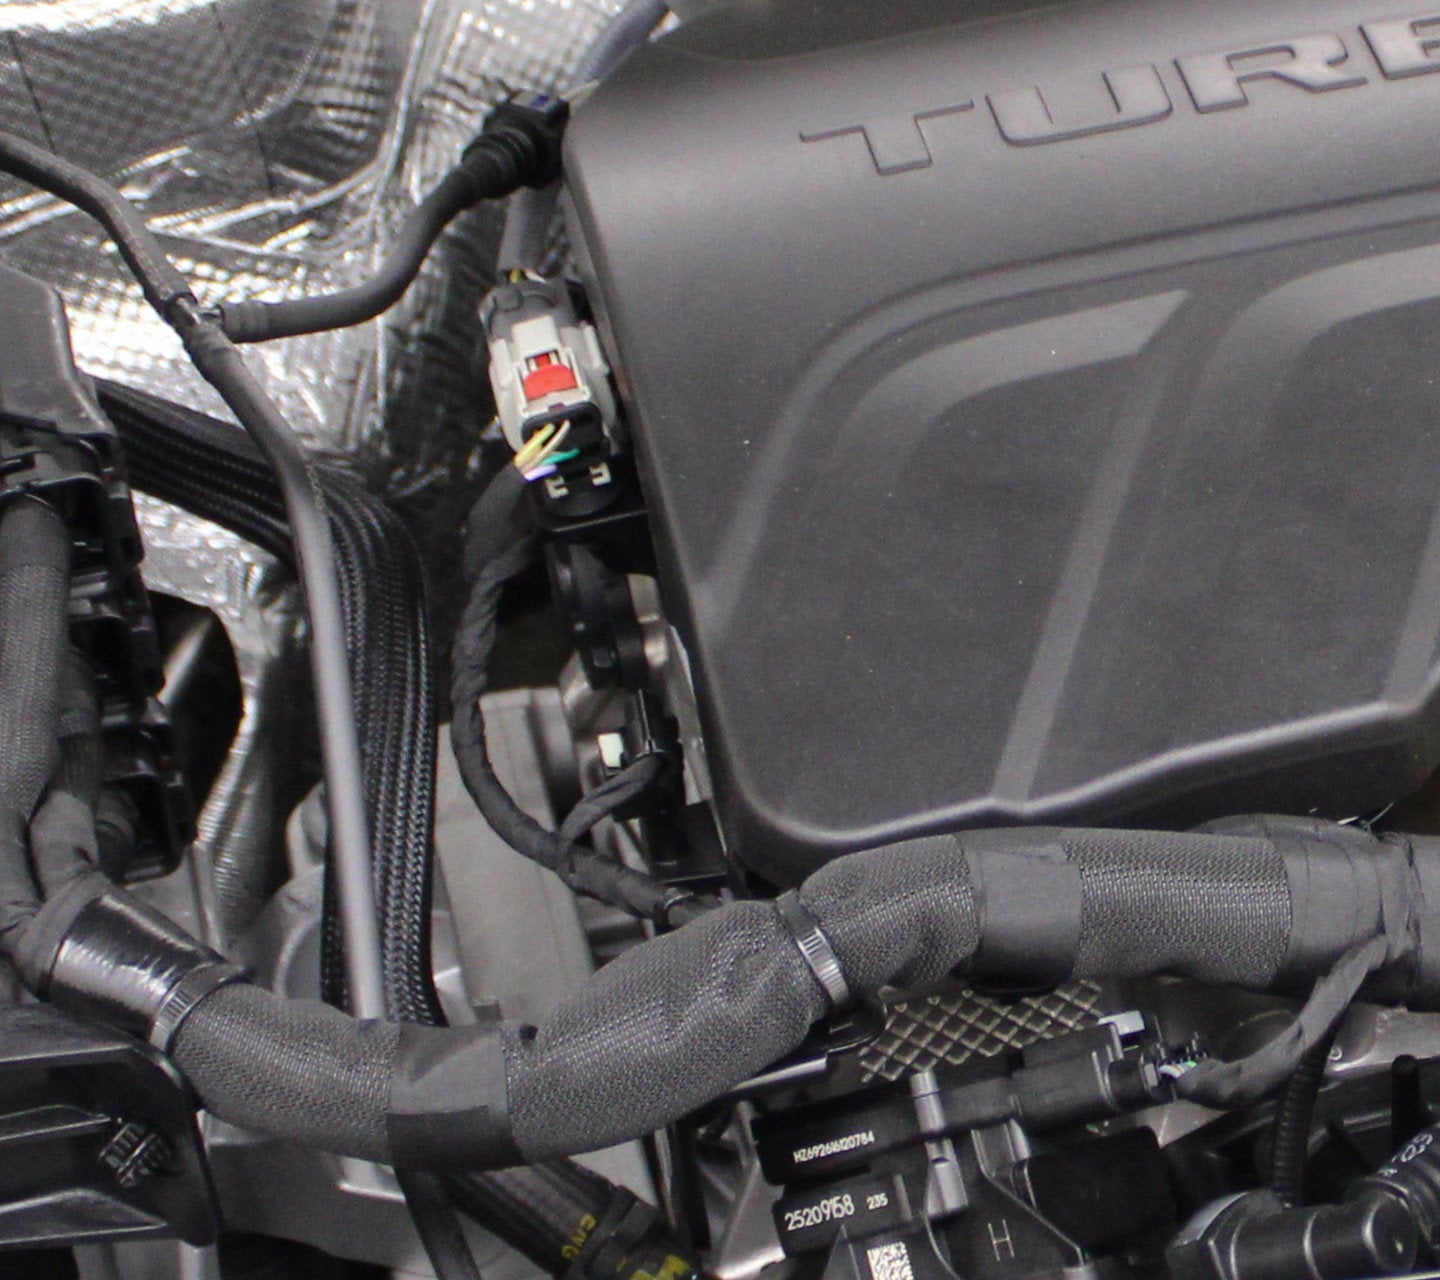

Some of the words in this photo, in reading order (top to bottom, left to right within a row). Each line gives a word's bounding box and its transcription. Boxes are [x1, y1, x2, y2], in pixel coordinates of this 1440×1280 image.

[783, 1193, 856, 1232] 25209158
[865, 1192, 889, 1211] 235
[987, 1219, 1016, 1262] H
